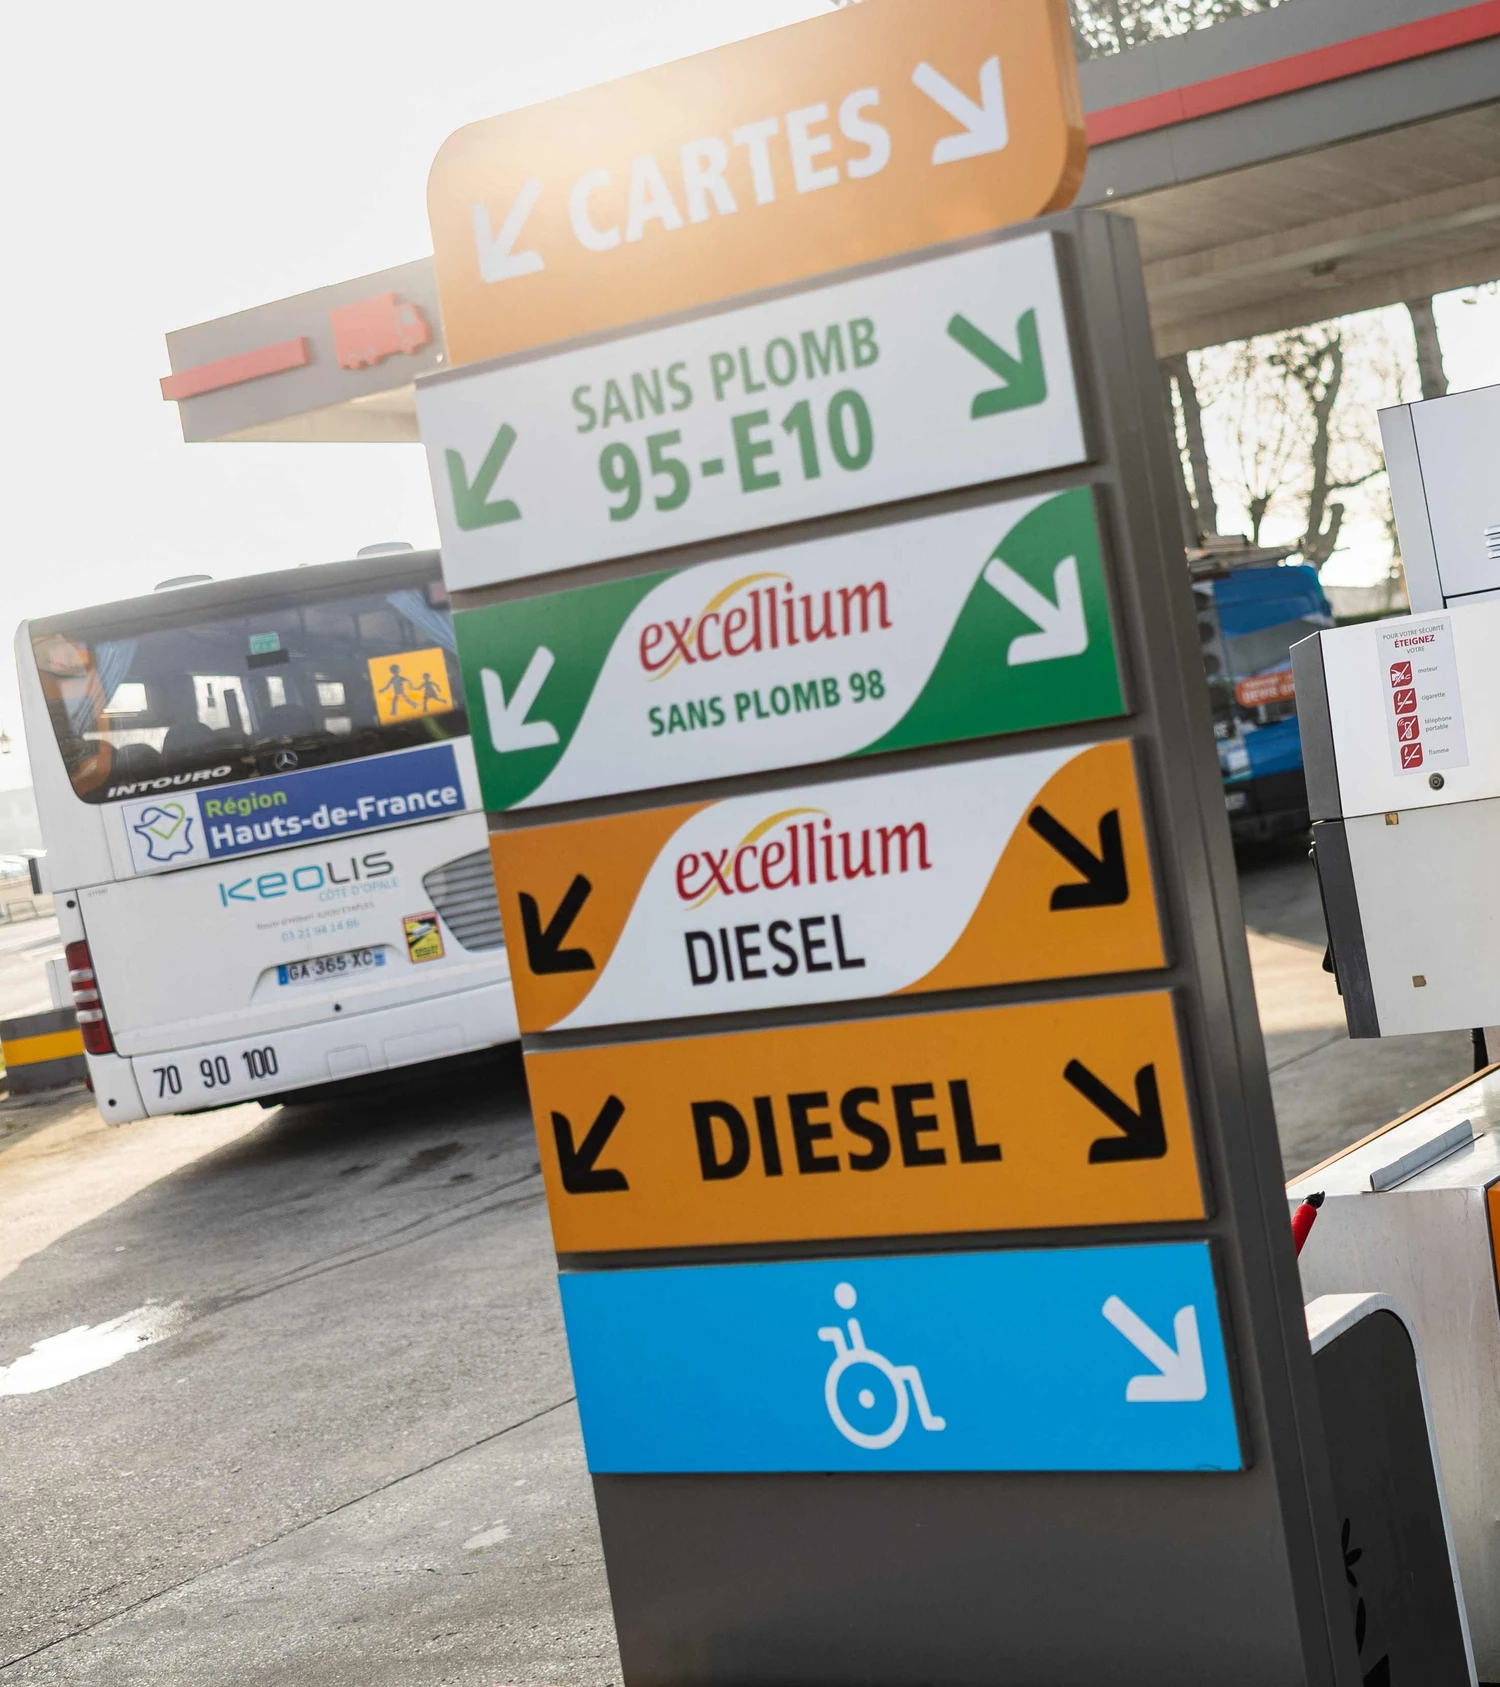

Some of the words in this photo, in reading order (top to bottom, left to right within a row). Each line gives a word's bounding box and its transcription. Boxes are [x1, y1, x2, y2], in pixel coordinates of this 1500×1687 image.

[569, 88, 892, 253] CARTES
[572, 361, 693, 433] SANS
[711, 317, 879, 401] PLOMB
[599, 389, 874, 520] 95-E10
[639, 579, 892, 672] excellium
[1383, 631, 1398, 640] POUR
[1399, 629, 1417, 638] VOTRE
[1419, 624, 1444, 634] SÉCURITÉ
[1394, 634, 1435, 648] ÉTEIGNEZ
[1406, 646, 1425, 654] VOTRE
[650, 695, 725, 736] SANS
[735, 680, 841, 723] PLOMB
[850, 670, 885, 703] 98
[1421, 692, 1446, 701] cigarette
[1425, 715, 1452, 724] téléphone
[1425, 723, 1449, 732] portable
[1428, 747, 1450, 755] flamme
[107, 765, 232, 798] INTOURO
[205, 791, 287, 819] Région
[210, 786, 458, 849] Hauts-de-France
[676, 820, 931, 901] excellium
[685, 914, 866, 985] DIESEL
[153, 1065, 182, 1099] 70
[200, 1055, 231, 1089] 90
[242, 1046, 279, 1080] 100
[690, 1079, 1002, 1181] DIESEL
